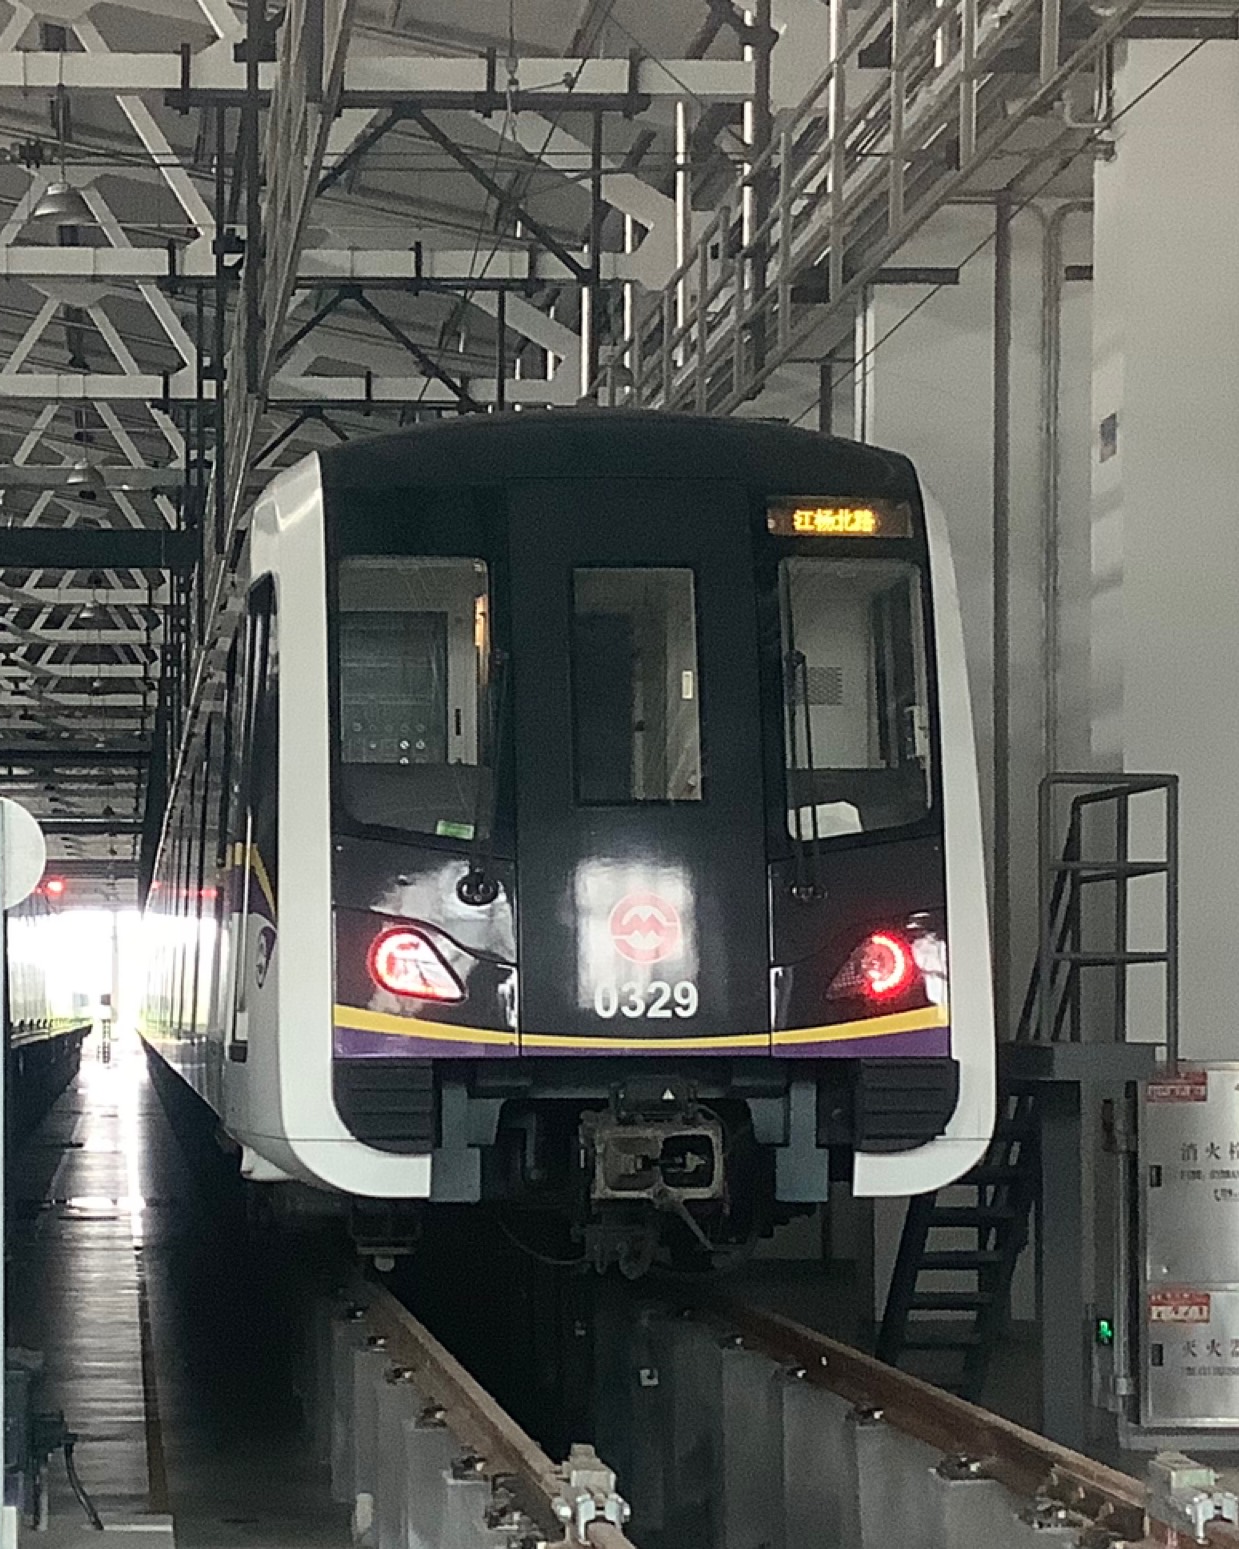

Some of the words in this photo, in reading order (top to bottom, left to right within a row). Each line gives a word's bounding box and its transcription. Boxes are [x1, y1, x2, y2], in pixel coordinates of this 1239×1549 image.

[793, 508, 875, 532] 江杨北路
[594, 981, 699, 1019] 0329
